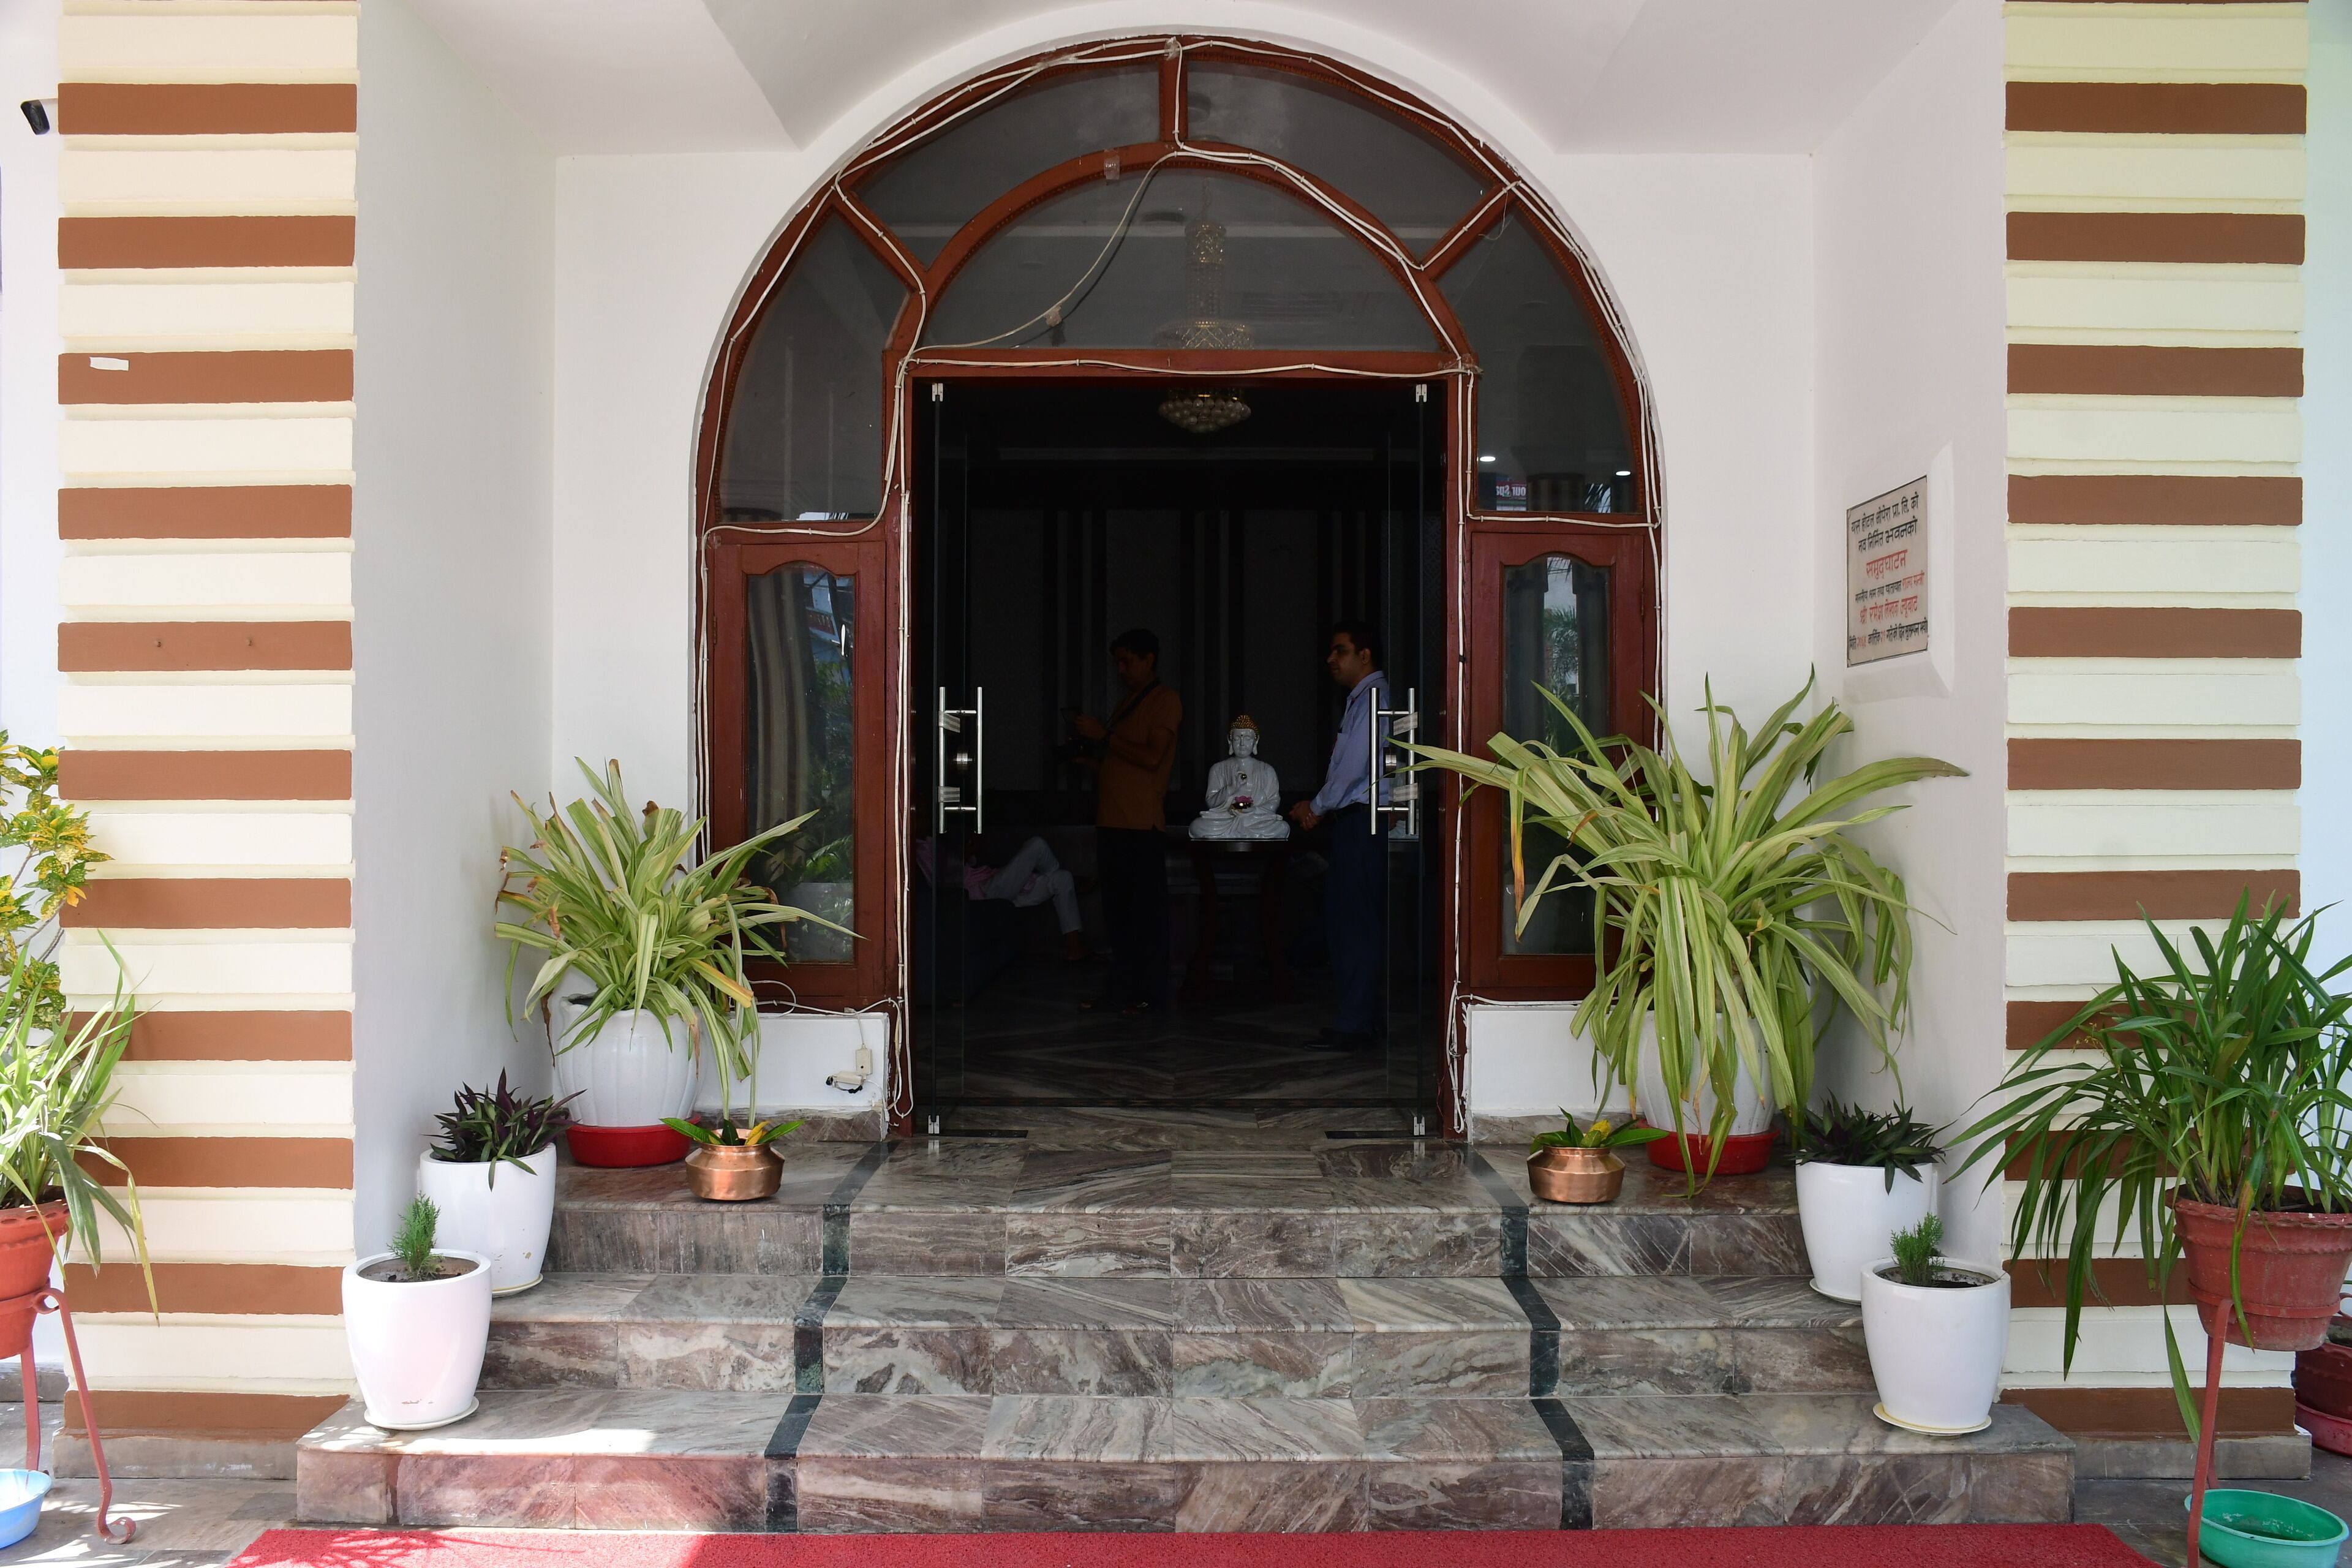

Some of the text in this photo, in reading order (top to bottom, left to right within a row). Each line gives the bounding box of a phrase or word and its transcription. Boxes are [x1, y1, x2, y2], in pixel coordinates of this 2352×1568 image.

[1861, 513, 1874, 532] होटल
[1911, 491, 1919, 510] को
[1858, 516, 1918, 553] नव निर्मित भवनको
